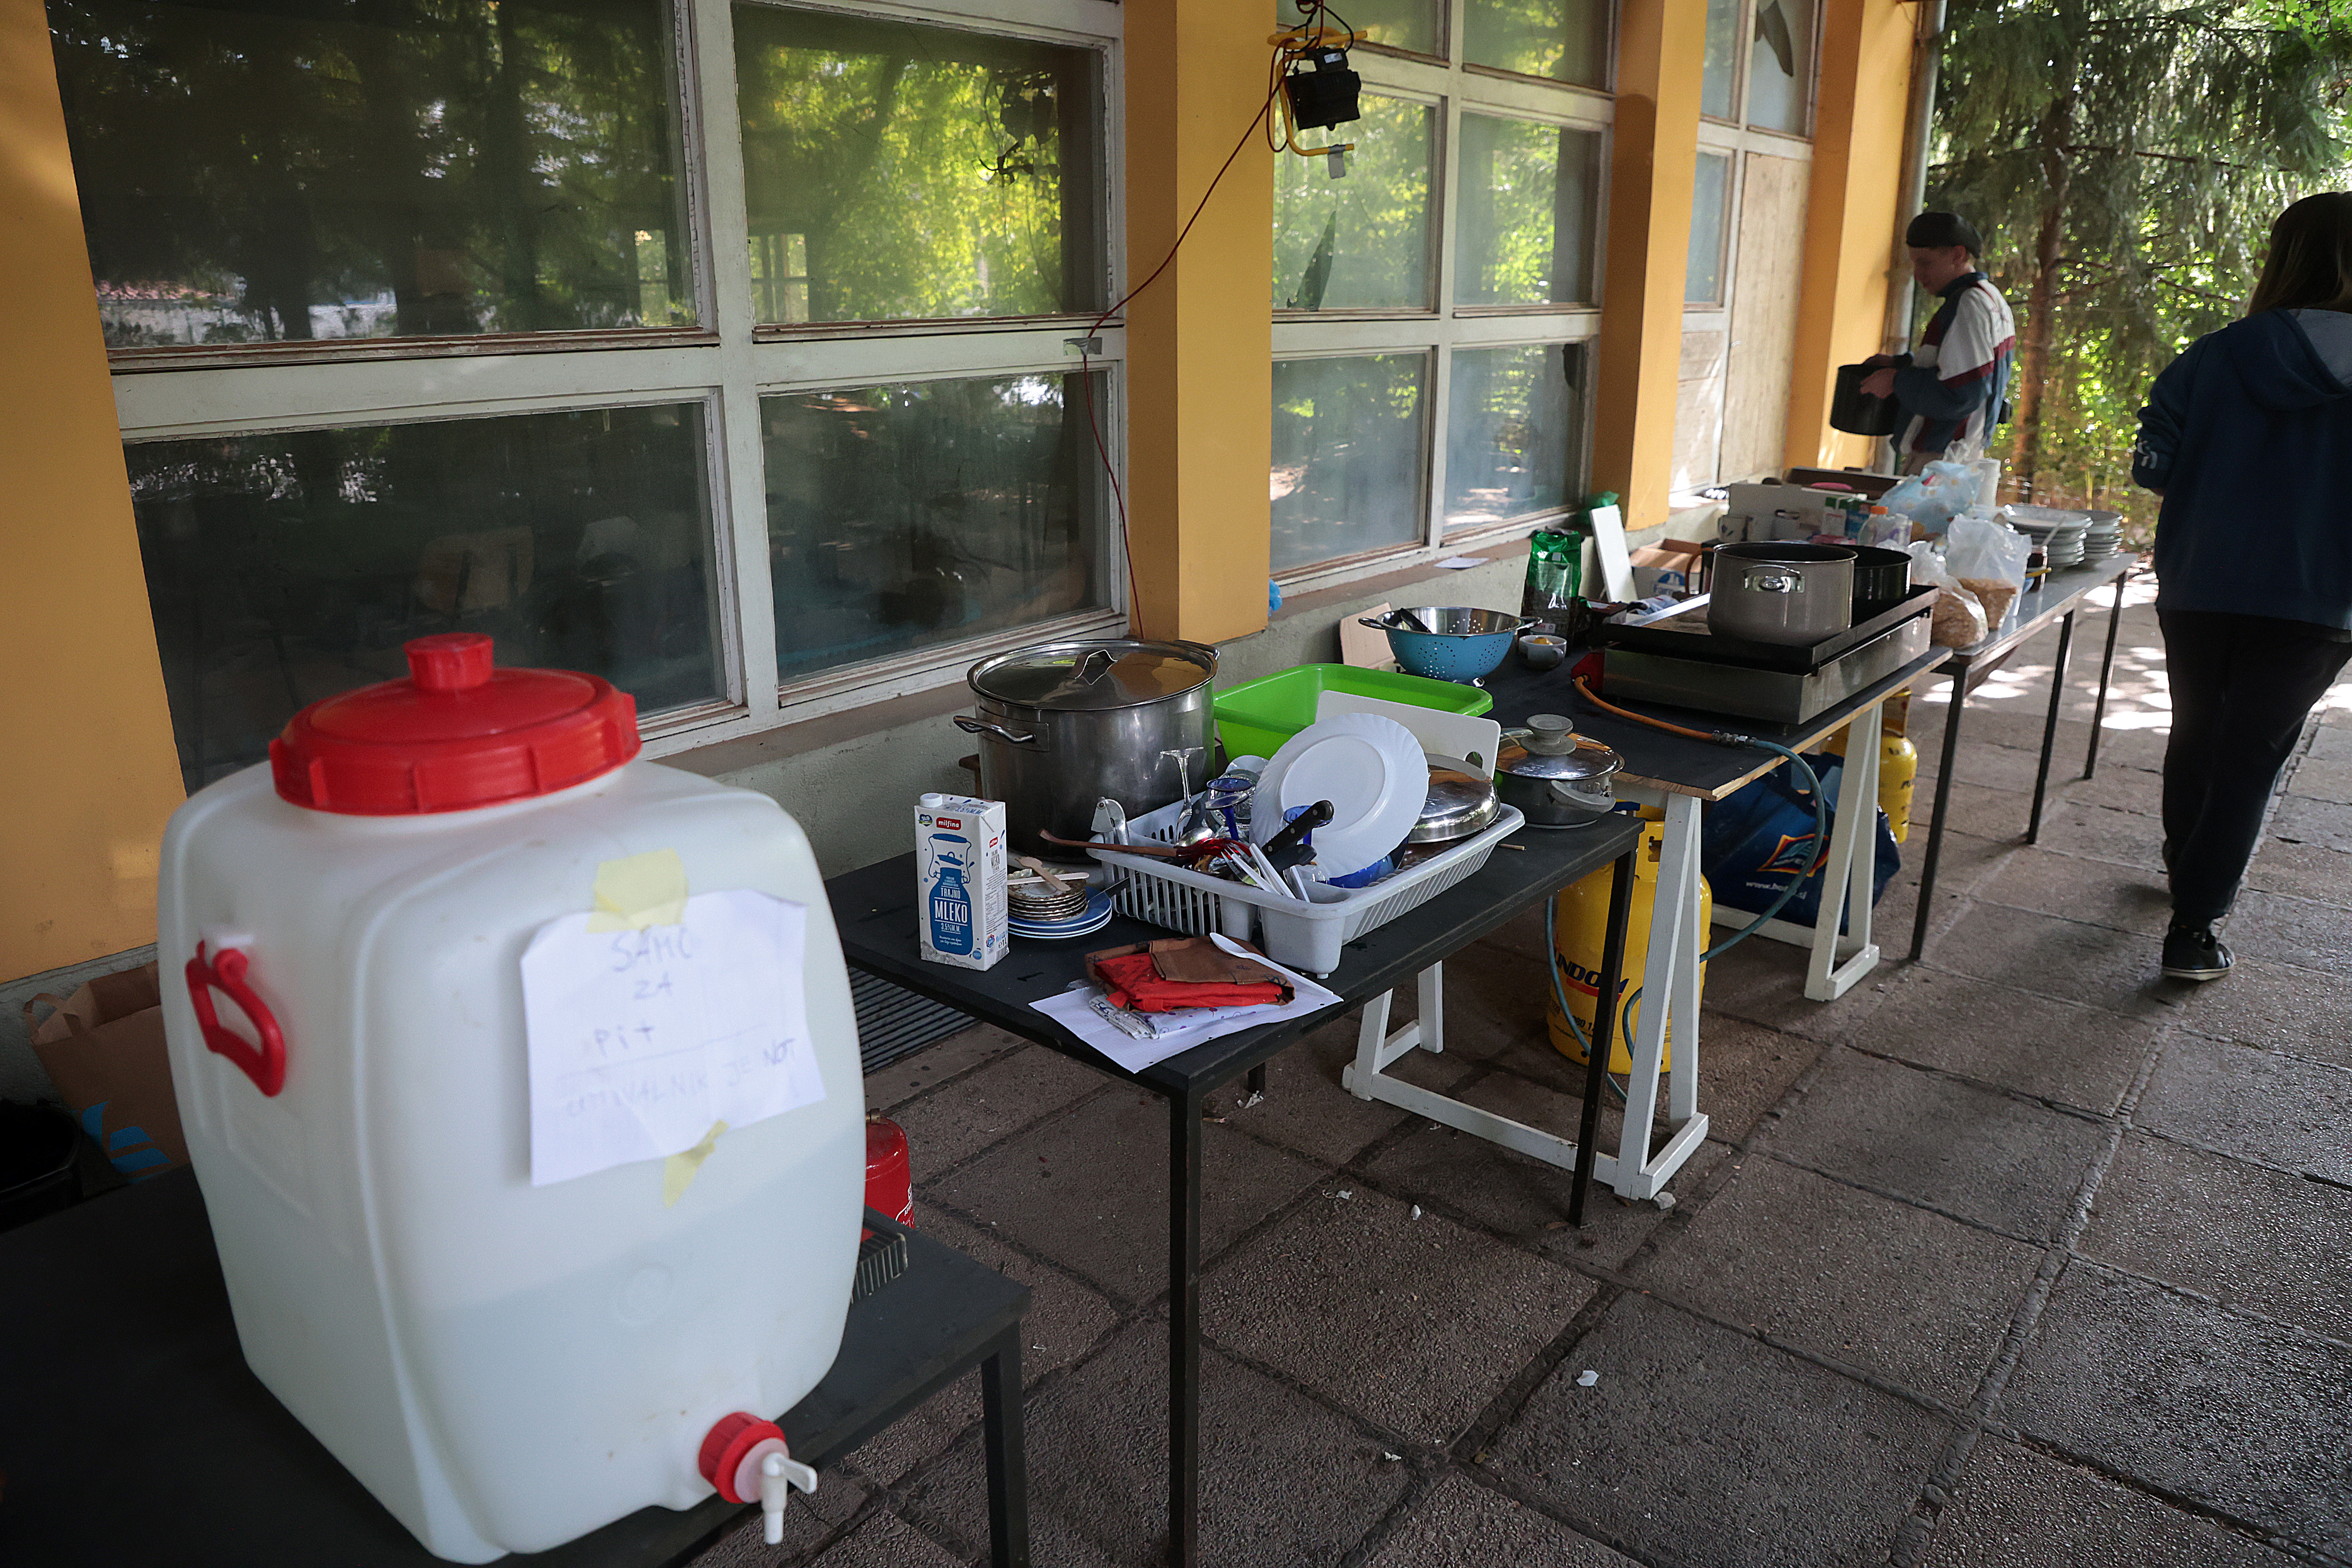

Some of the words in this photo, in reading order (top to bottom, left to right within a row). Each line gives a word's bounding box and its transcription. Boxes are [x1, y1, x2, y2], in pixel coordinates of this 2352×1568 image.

[940, 887, 961, 899] TRAJNO
[934, 900, 968, 923] MLEKO
[632, 970, 673, 1001] ZA
[721, 1056, 753, 1087] JE
